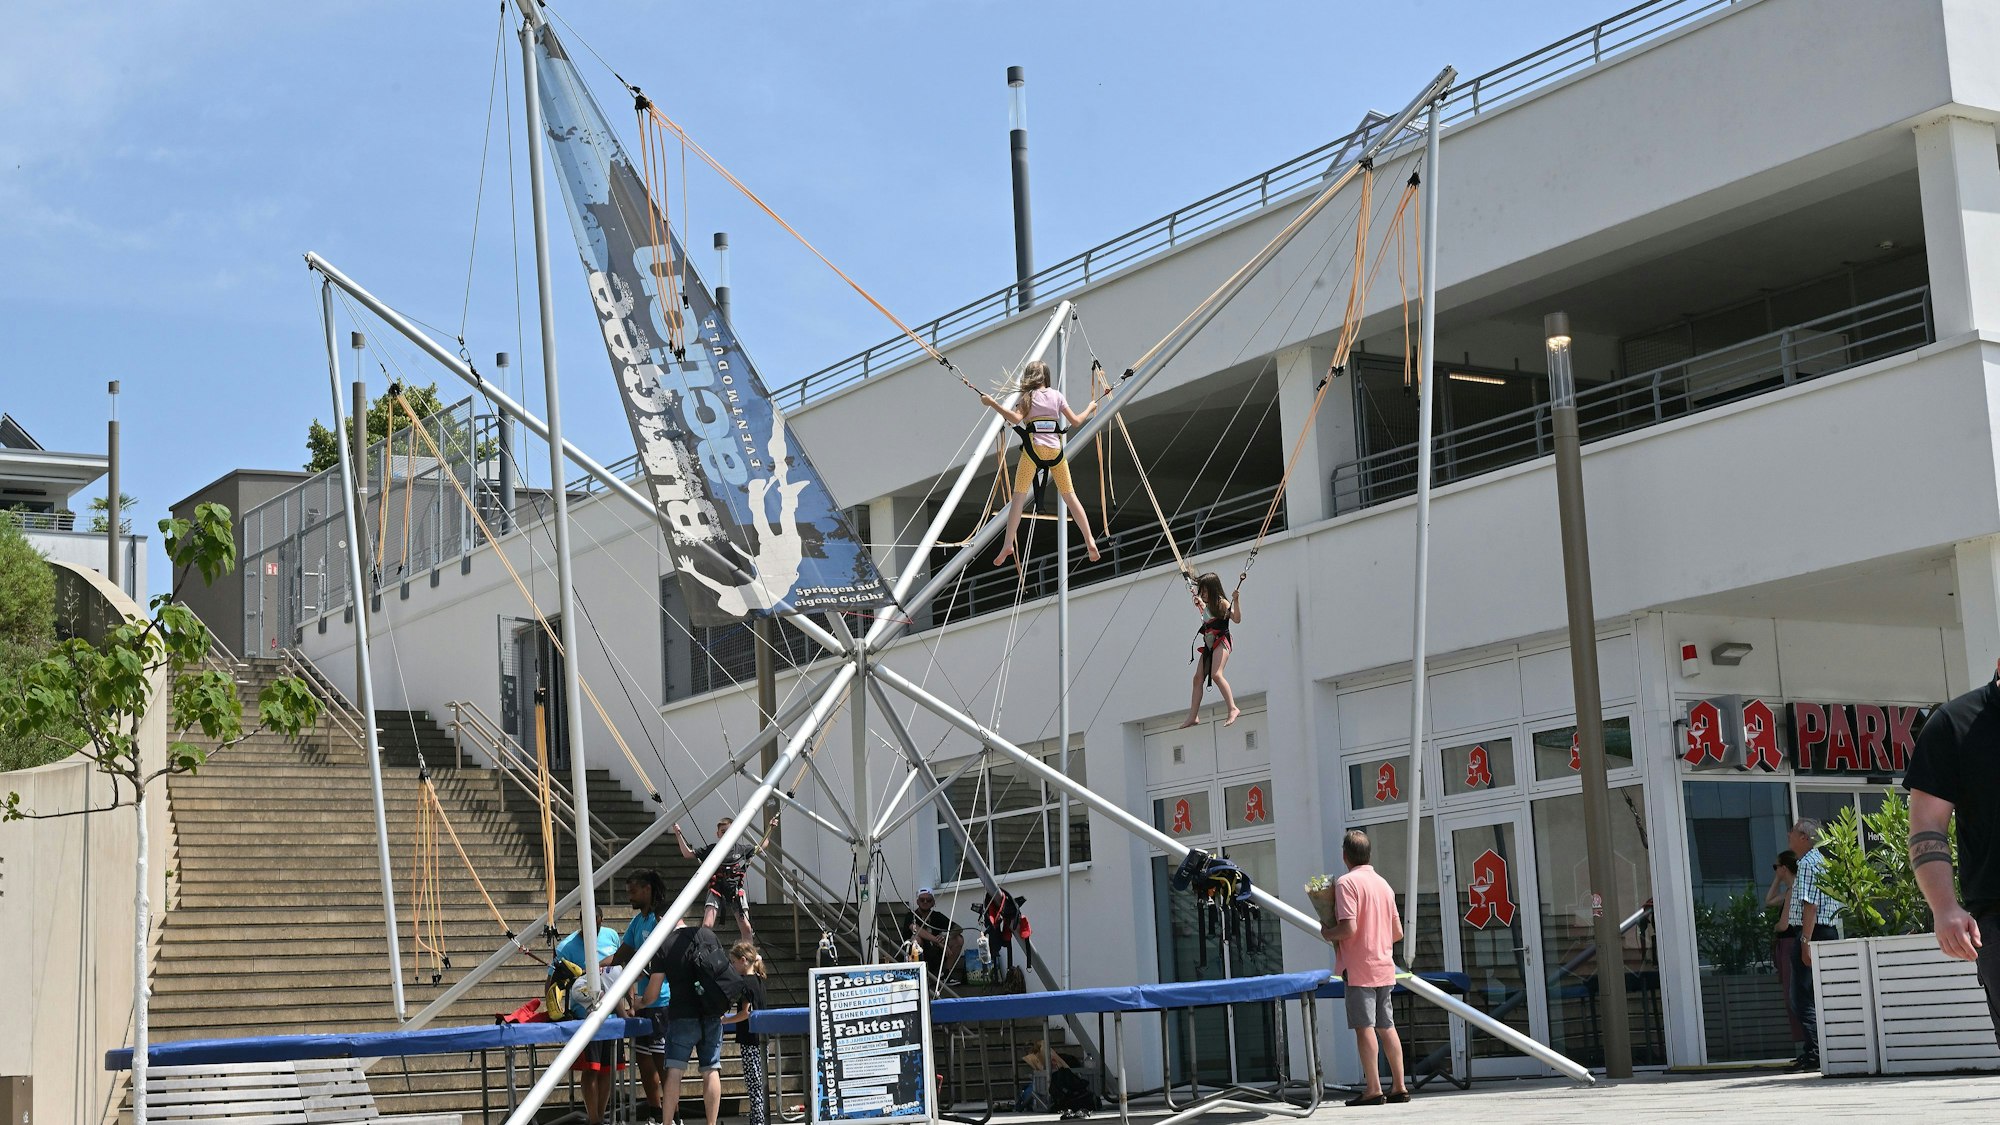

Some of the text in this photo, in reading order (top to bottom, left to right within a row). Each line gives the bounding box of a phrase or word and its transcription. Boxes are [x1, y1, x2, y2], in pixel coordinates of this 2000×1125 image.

[633, 244, 748, 485] action
[705, 319, 761, 468] EVENTMODULE
[795, 579, 880, 597] Springen auf
[795, 592, 884, 607] eigene Gefahr
[1795, 702, 1919, 771] PARK
[829, 972, 895, 989] Preise
[833, 986, 889, 998] EINZELSPRUNG
[834, 996, 886, 1009] FÜNFERKARTE
[835, 1008, 888, 1019] ZEHNERKARTE
[833, 1019, 905, 1037] Fakten
[817, 979, 839, 1116] BUNGEE TRAMPOLIN
